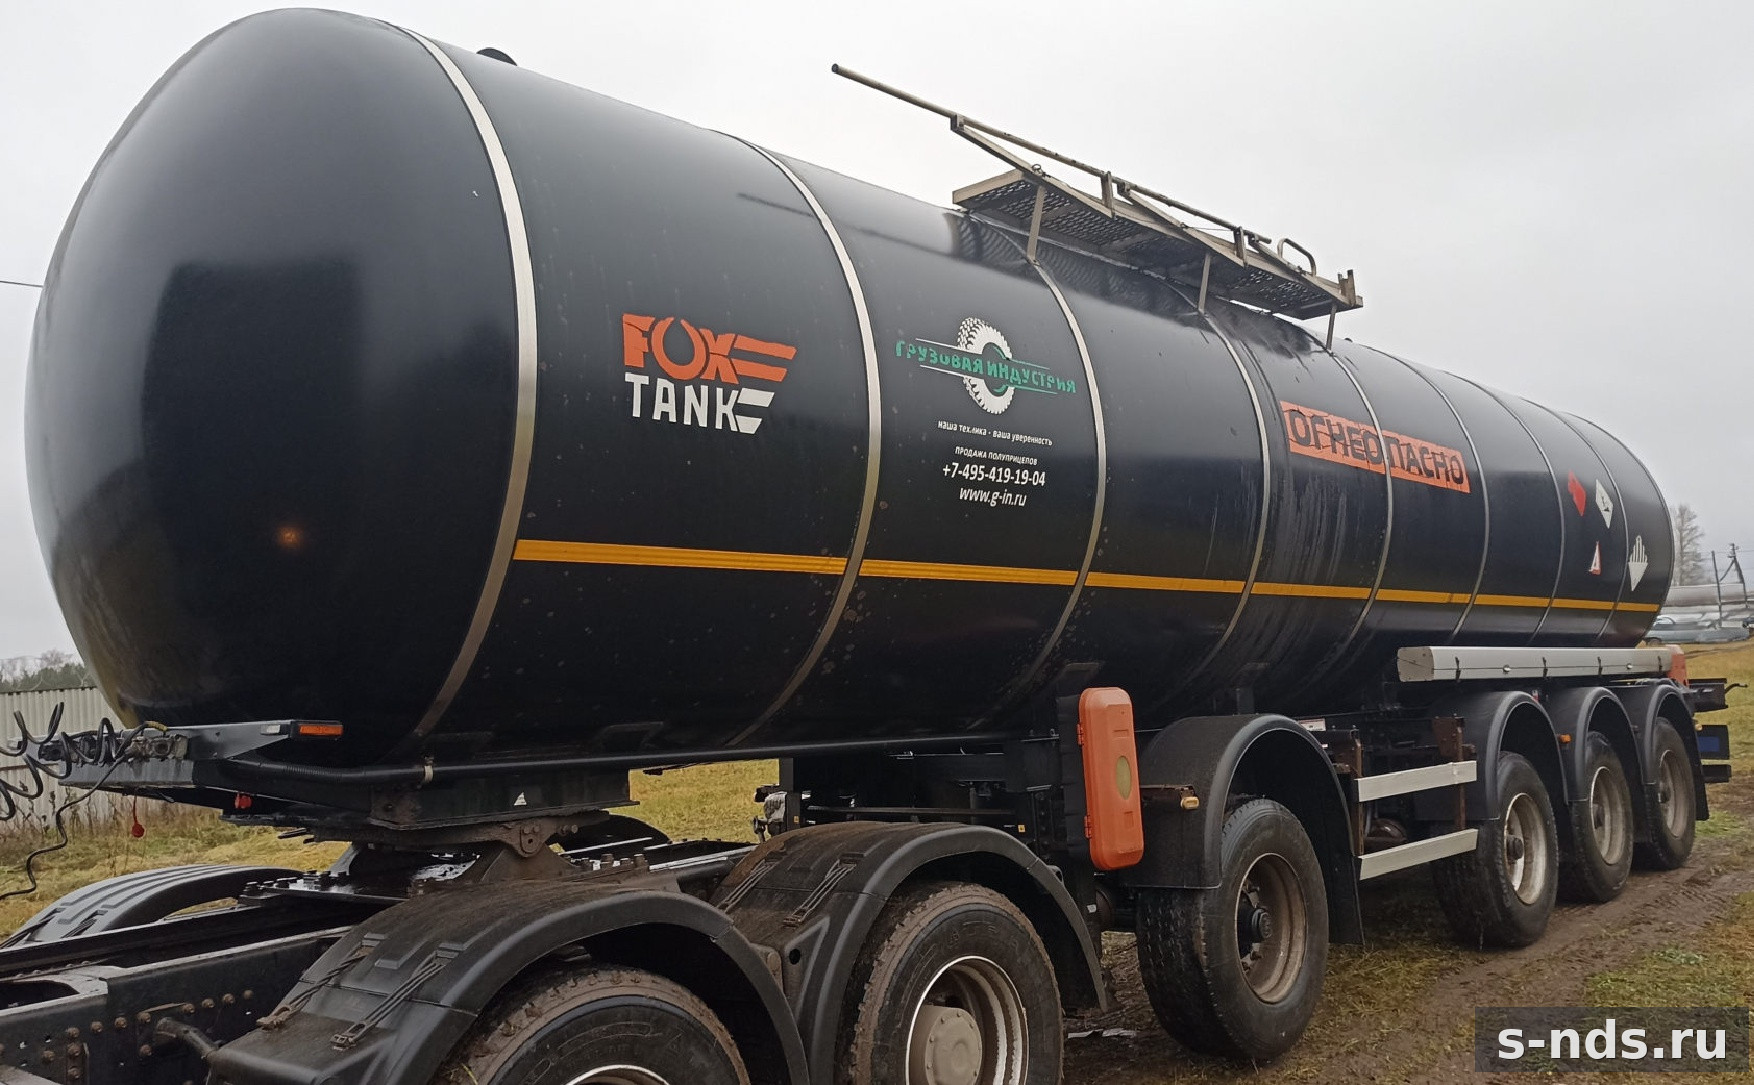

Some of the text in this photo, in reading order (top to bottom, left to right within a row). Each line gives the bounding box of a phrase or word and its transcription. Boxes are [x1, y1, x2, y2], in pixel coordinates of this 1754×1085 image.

[622, 313, 739, 385] FOX
[895, 340, 1077, 394] ГРУЗОВАЯ ИНДУСТРИЯ
[624, 371, 739, 432] TANK
[955, 446, 1038, 466] ПРОДАЖА ПОЛУПРИЦЕПОВ
[1011, 432, 1053, 447] уверенность
[1288, 408, 1465, 486] ОГНЕОПАСНО
[942, 462, 1046, 487] +7-495-419-19-04
[959, 487, 1028, 507] www.g-in.ru
